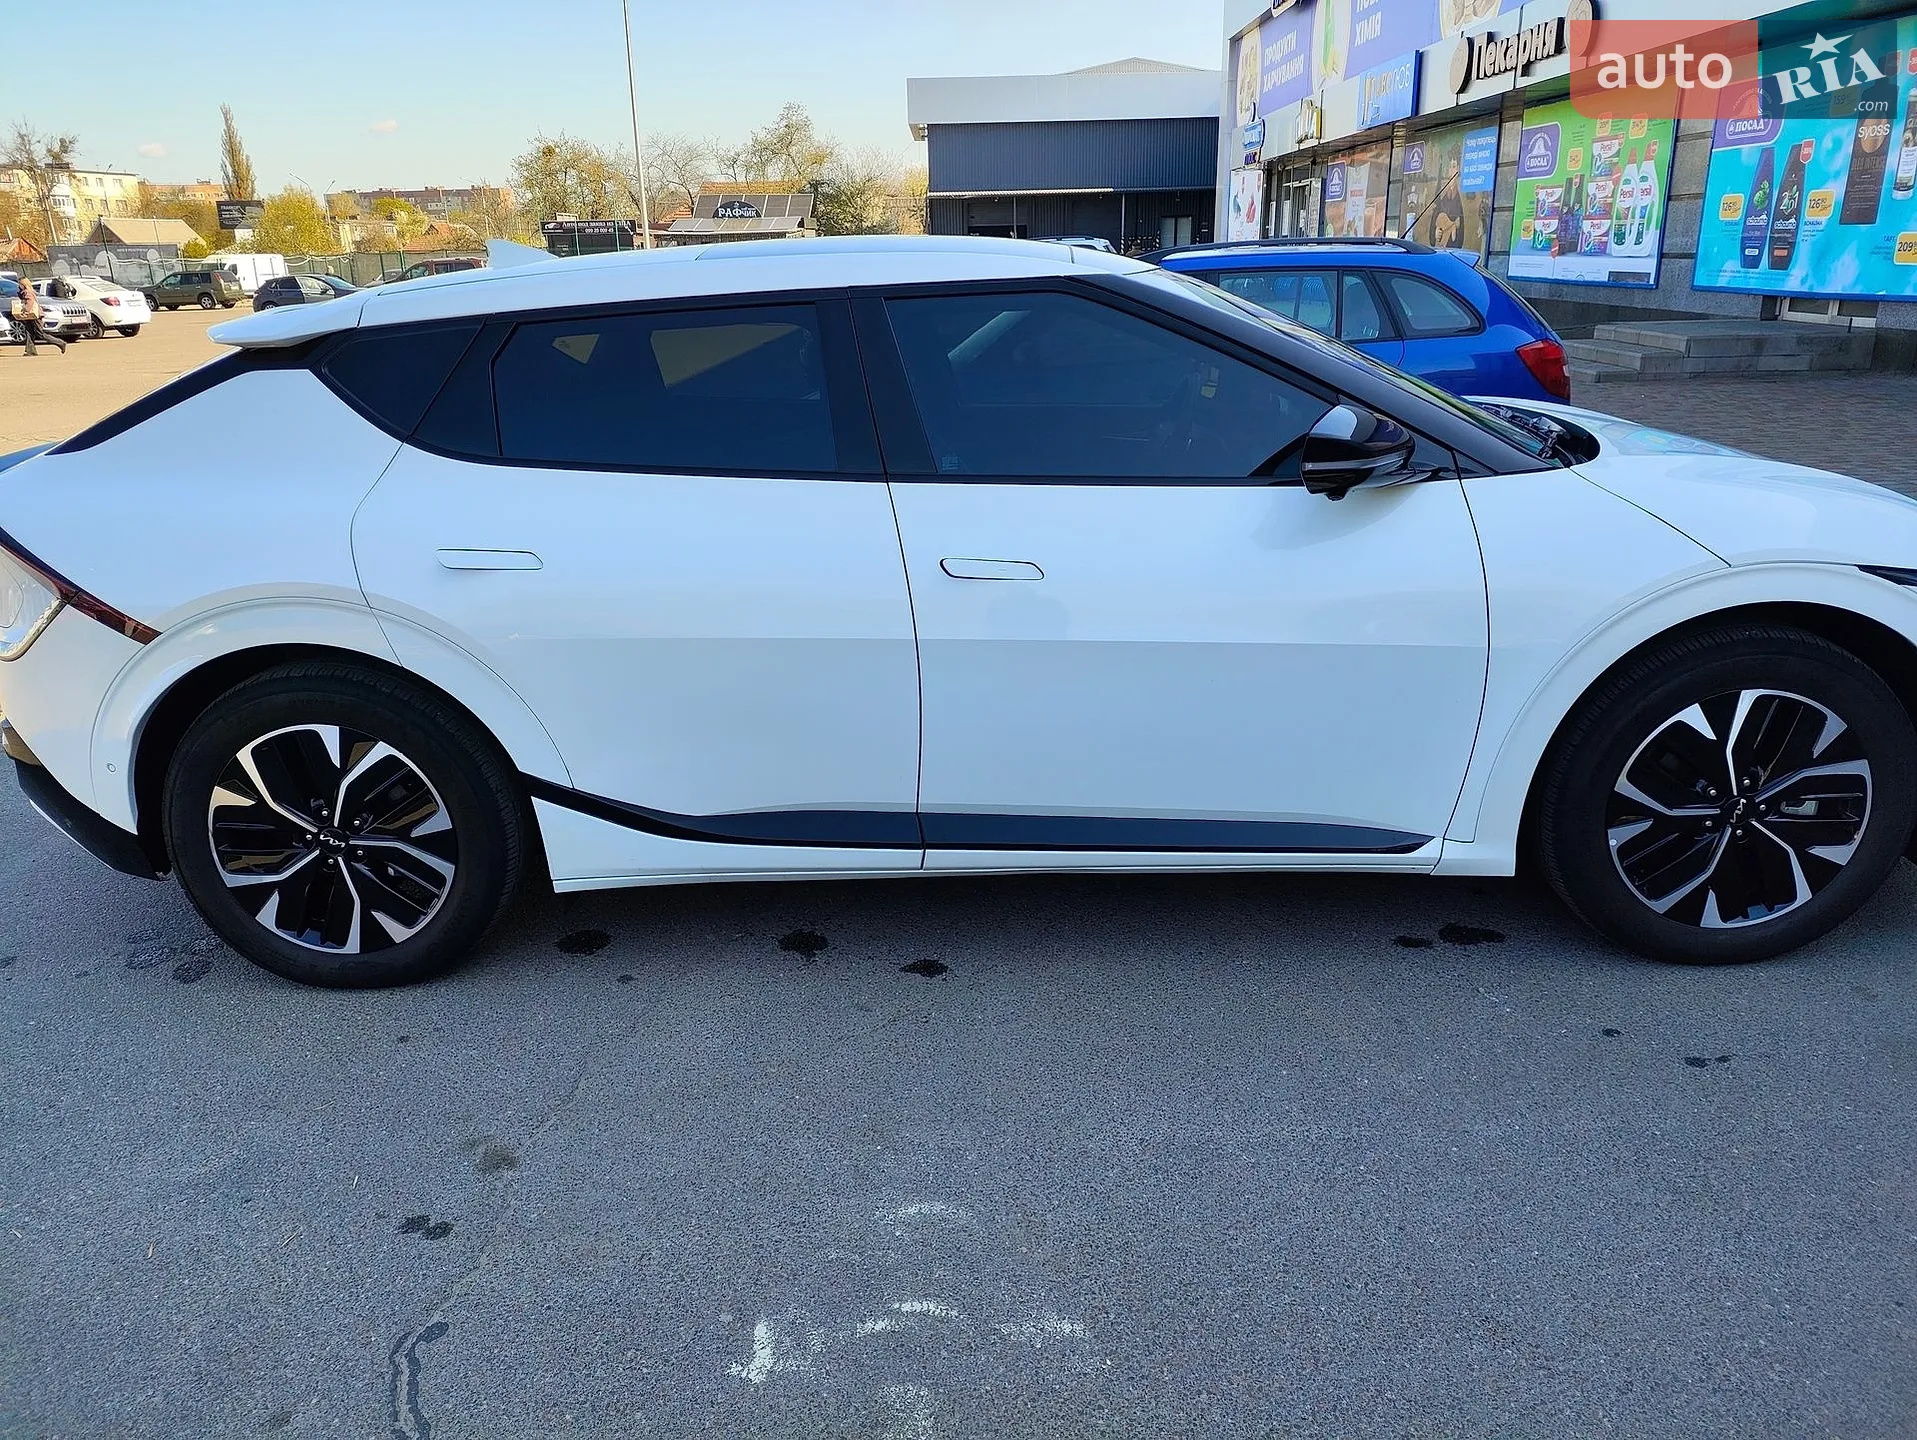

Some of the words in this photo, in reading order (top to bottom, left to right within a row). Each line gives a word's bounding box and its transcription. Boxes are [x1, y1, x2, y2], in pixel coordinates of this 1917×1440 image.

[1354, 12, 1382, 47] ХІМІЯ
[1264, 30, 1297, 67] ПРОДУКТИ
[1472, 17, 1558, 79] Пекарня
[1262, 54, 1304, 94] ХАРЧУВАННЯ
[1735, 118, 1765, 132] ПОСАД
[1640, 185, 1652, 197] ersil
[1808, 199, 1821, 209] 126
[1897, 241, 1914, 252] 209
